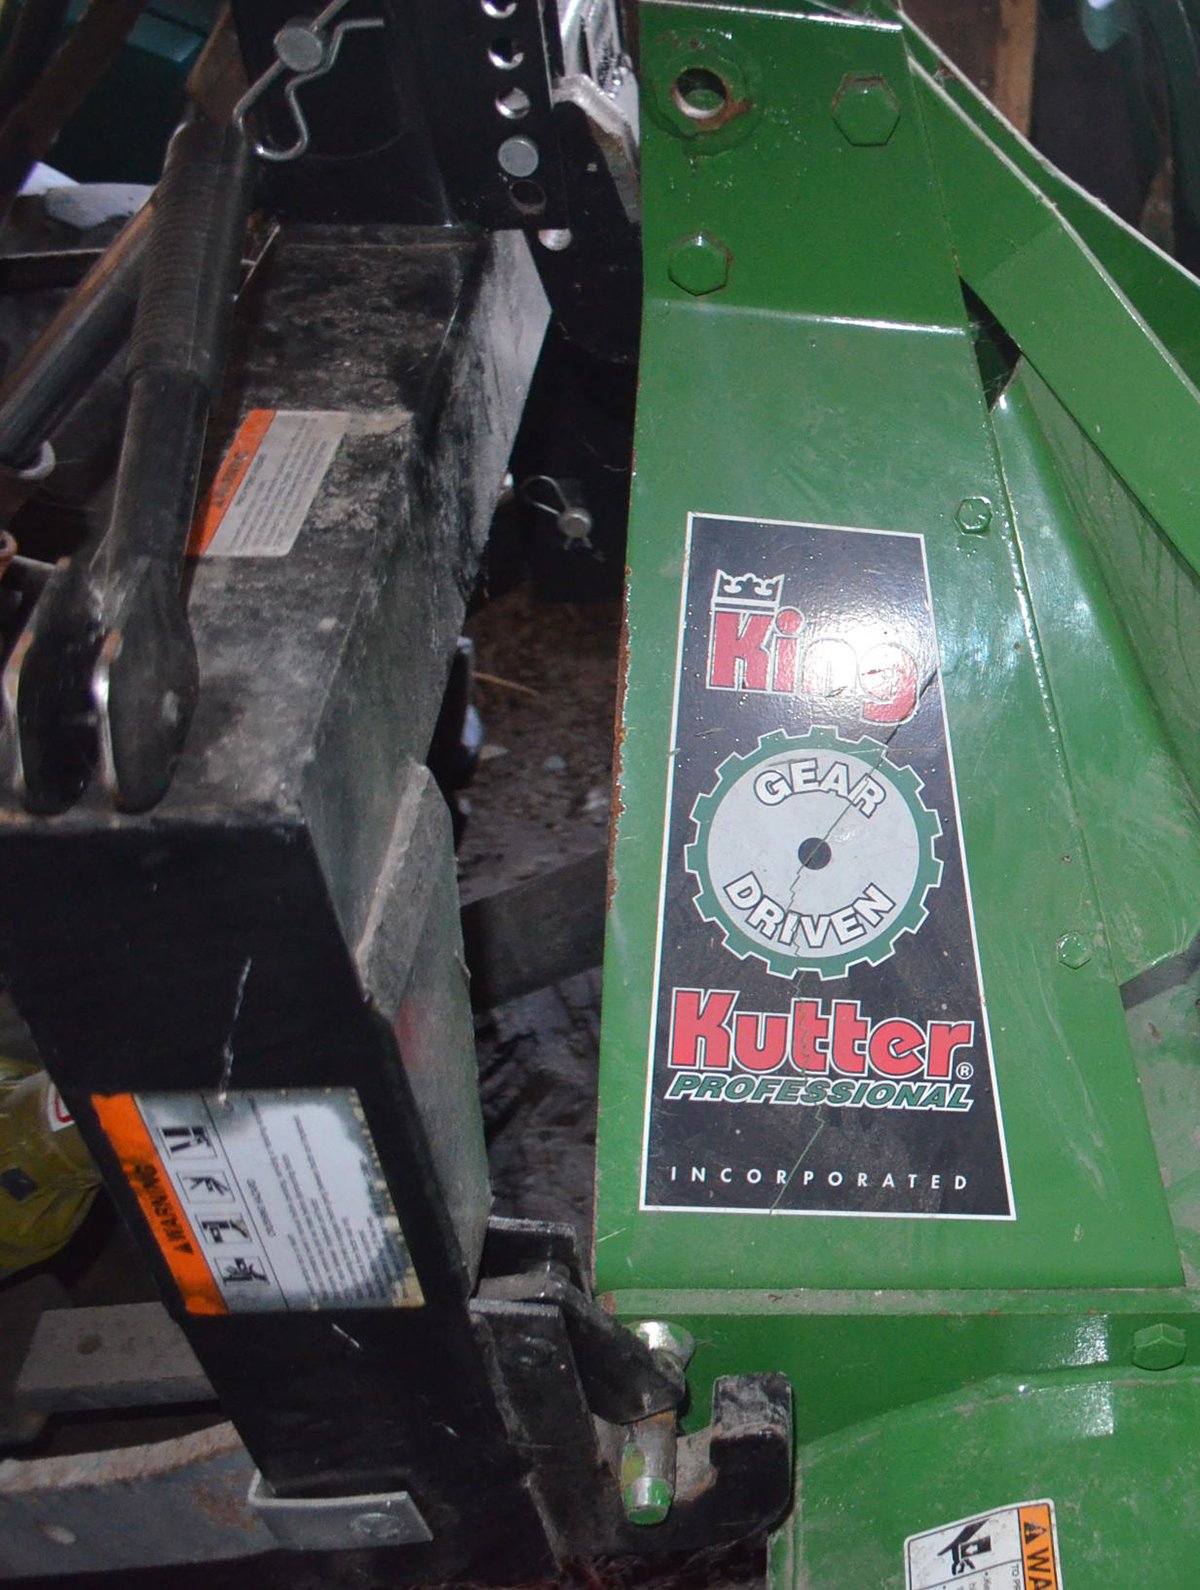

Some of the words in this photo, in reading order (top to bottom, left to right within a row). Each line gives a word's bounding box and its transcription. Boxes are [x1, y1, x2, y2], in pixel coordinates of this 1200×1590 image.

[706, 606, 919, 726] King
[754, 758, 887, 818] GEAR
[724, 871, 897, 948] DRIVEN
[664, 1071, 975, 1112] PROFESSIONAL
[671, 1165, 968, 1191] INCORPORATED
